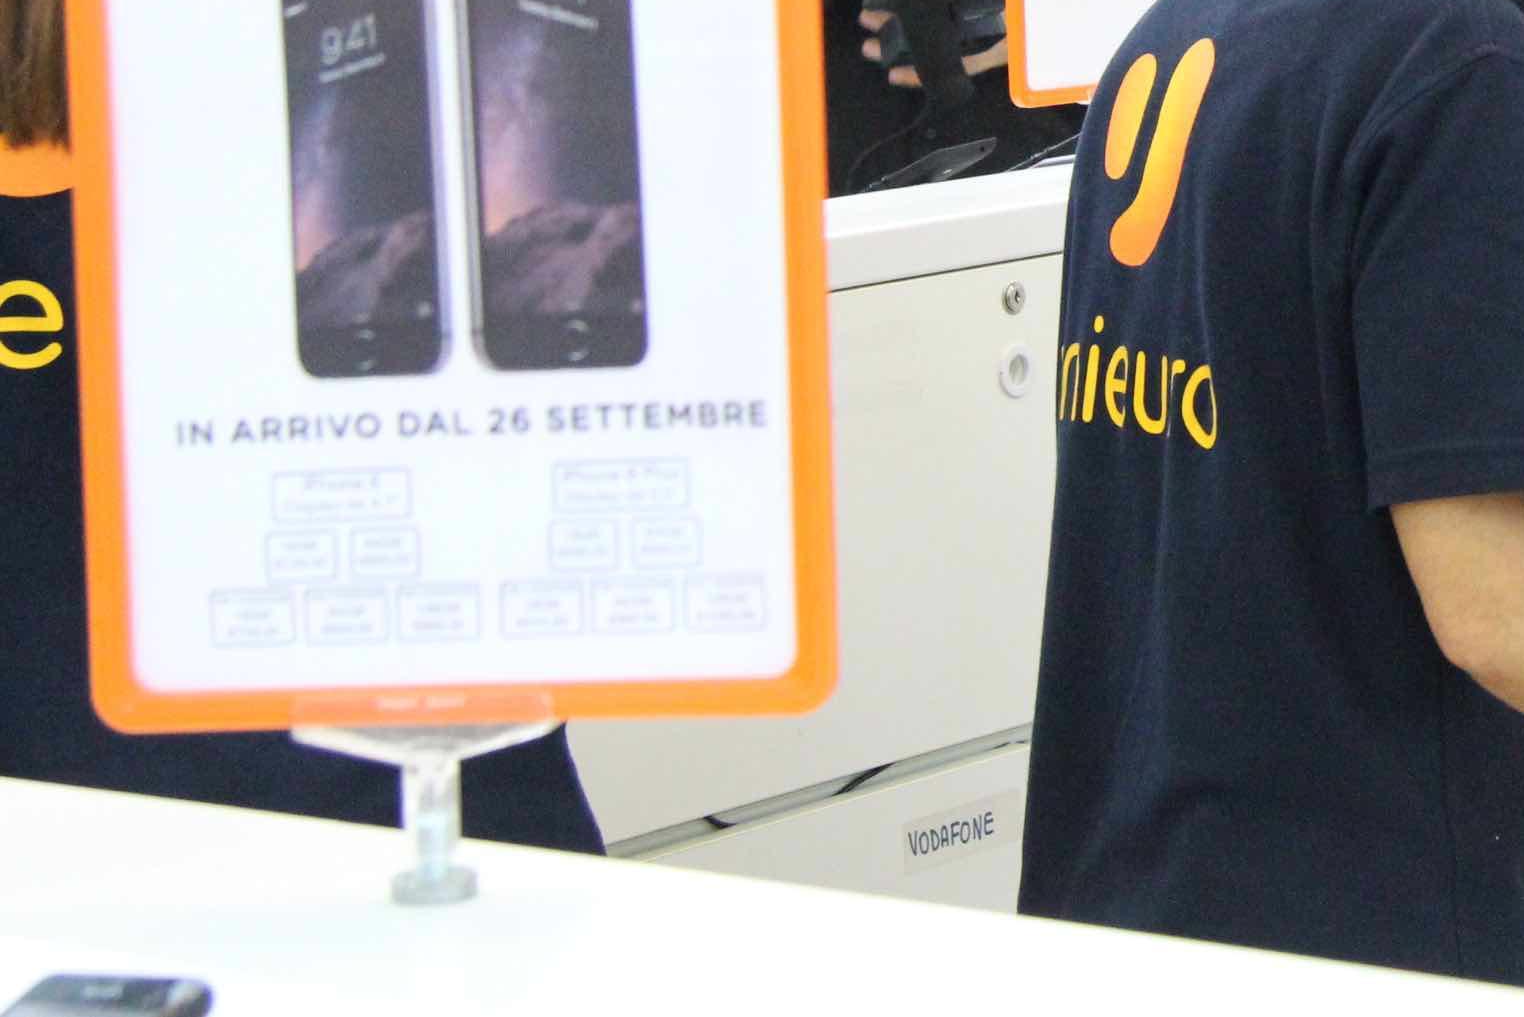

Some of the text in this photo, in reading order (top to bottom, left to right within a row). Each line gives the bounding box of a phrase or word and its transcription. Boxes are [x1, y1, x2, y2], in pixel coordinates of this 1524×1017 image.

[1058, 315, 1218, 451] nieuro
[177, 400, 768, 448] IN ARRIVO DAL 26 SETTEMBRE
[907, 810, 995, 858] VODAFONE
